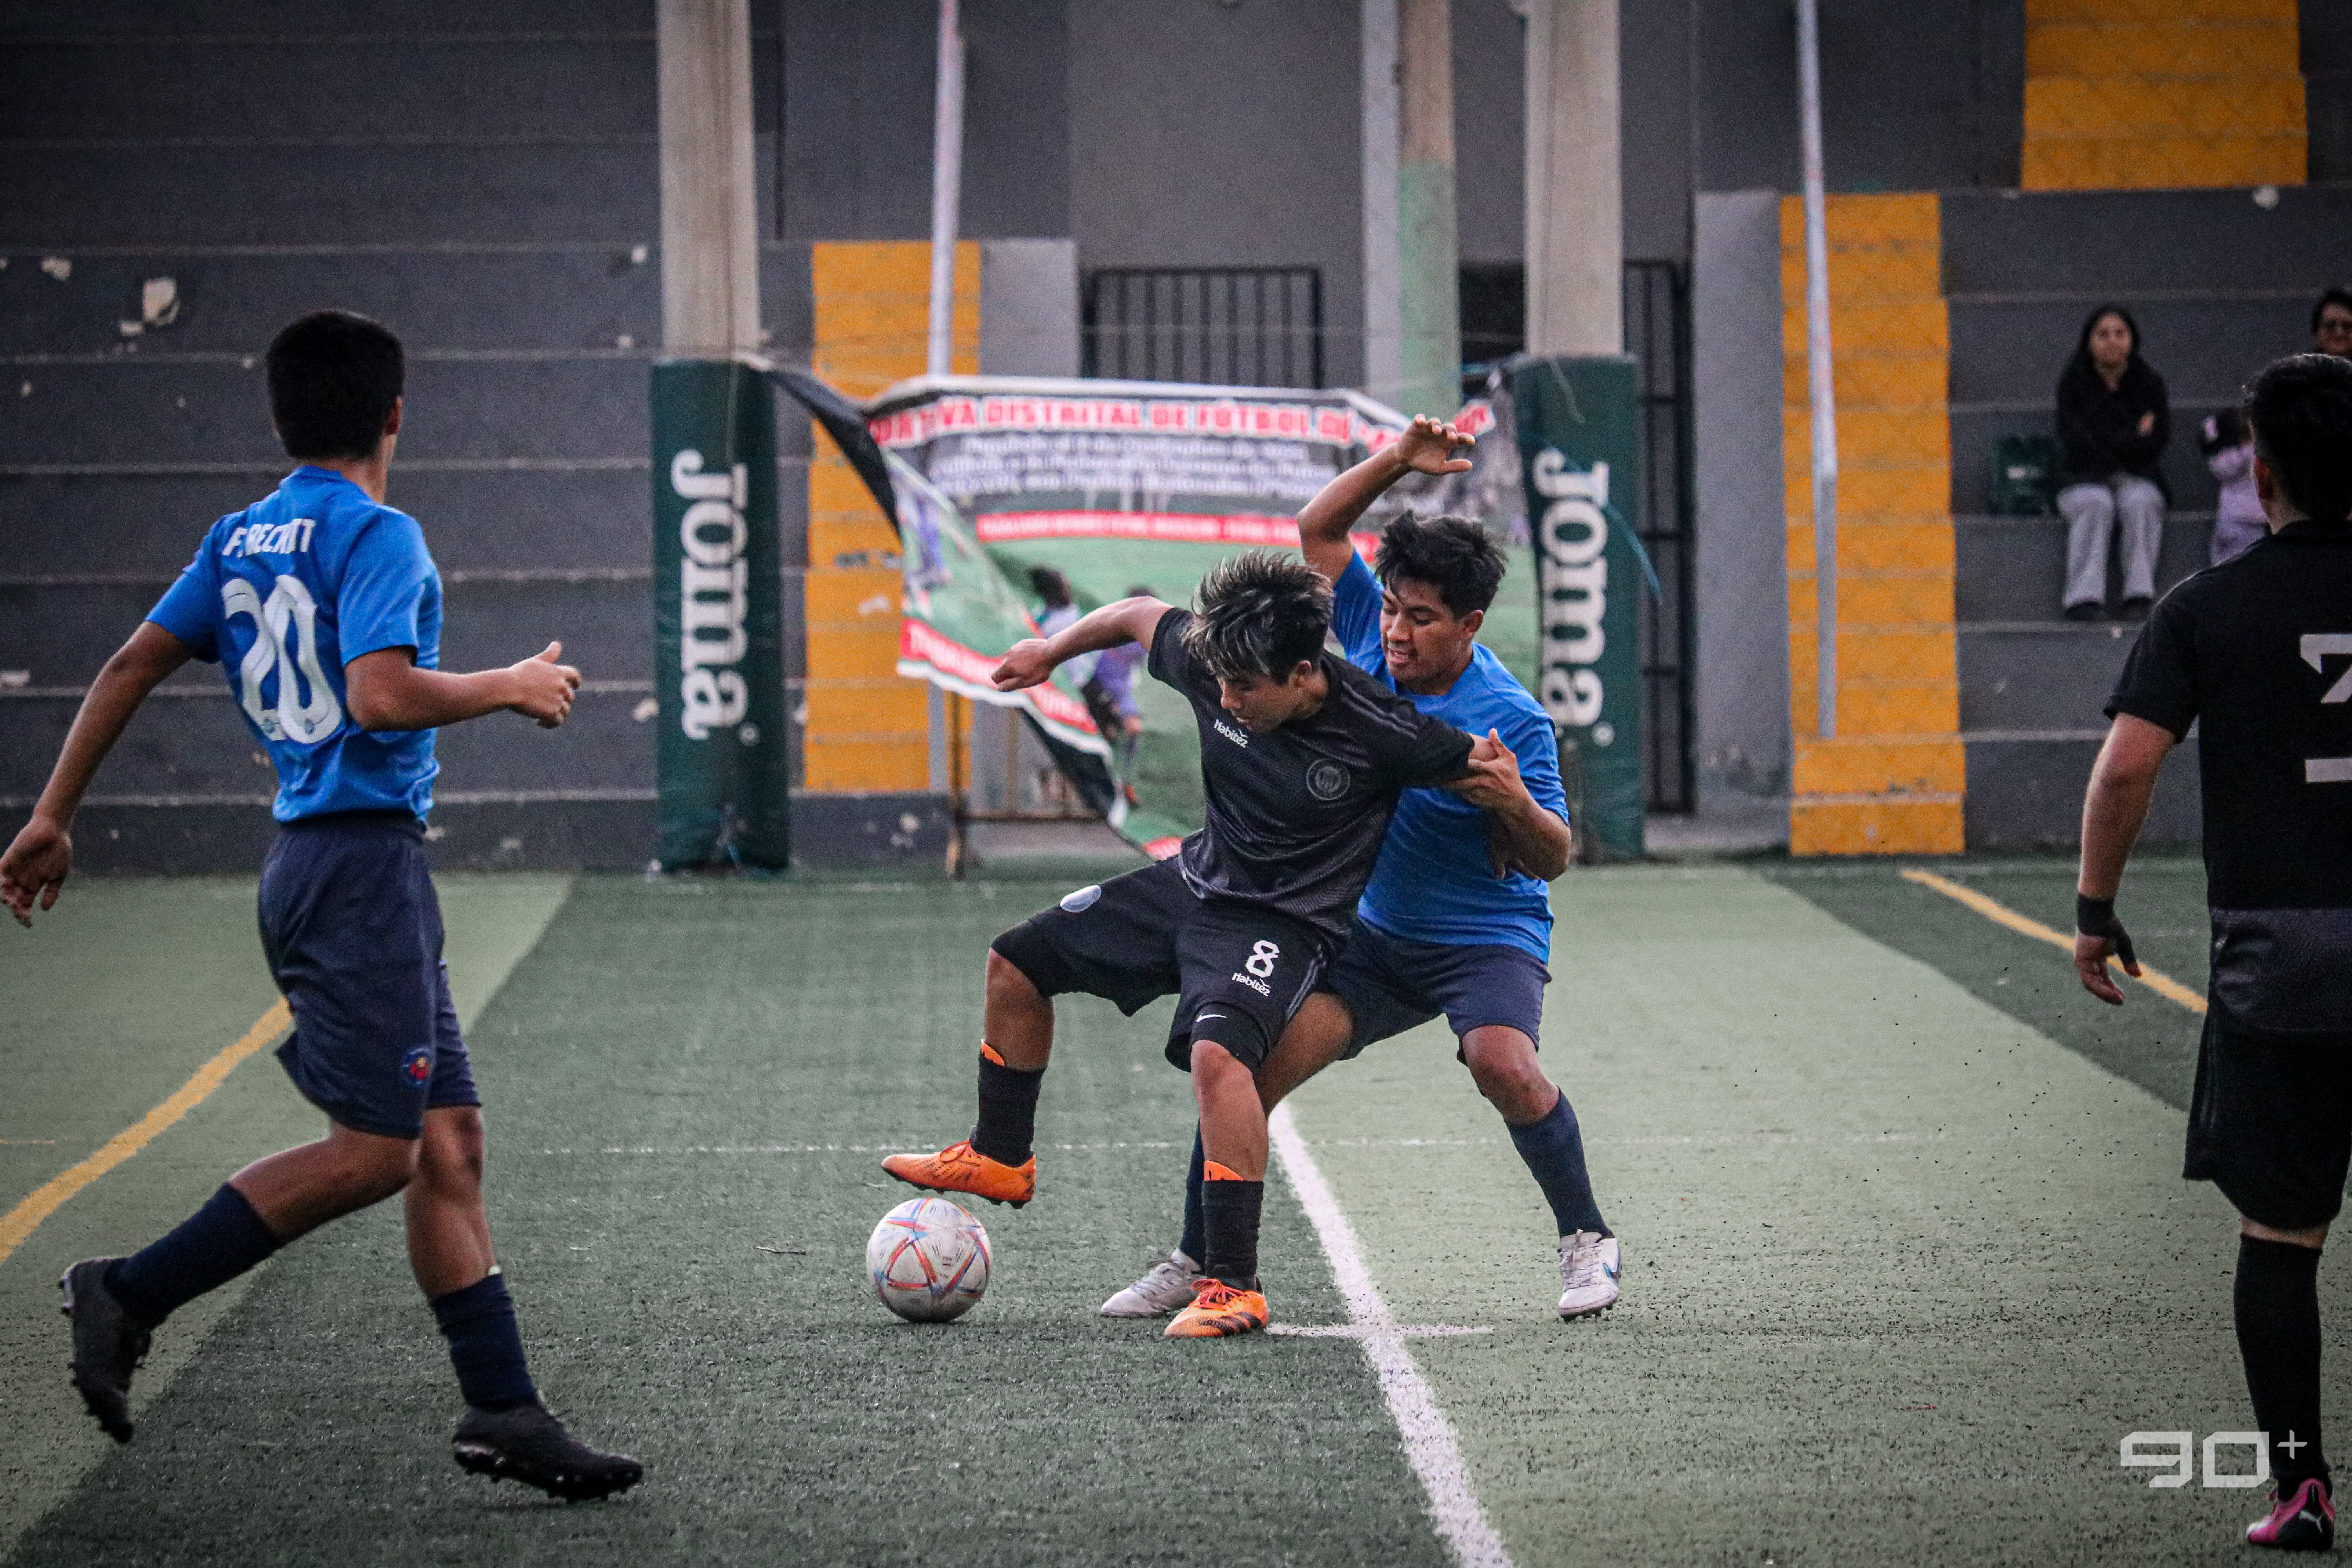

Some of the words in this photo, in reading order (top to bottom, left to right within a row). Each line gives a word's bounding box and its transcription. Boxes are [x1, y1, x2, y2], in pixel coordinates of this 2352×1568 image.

[985, 398, 1141, 429] DISTRITAL
[1152, 403, 1187, 430] DE
[221, 574, 341, 744] 20
[671, 448, 748, 740] Joma
[1533, 447, 1610, 738] Joma
[1245, 940, 1280, 978] 8
